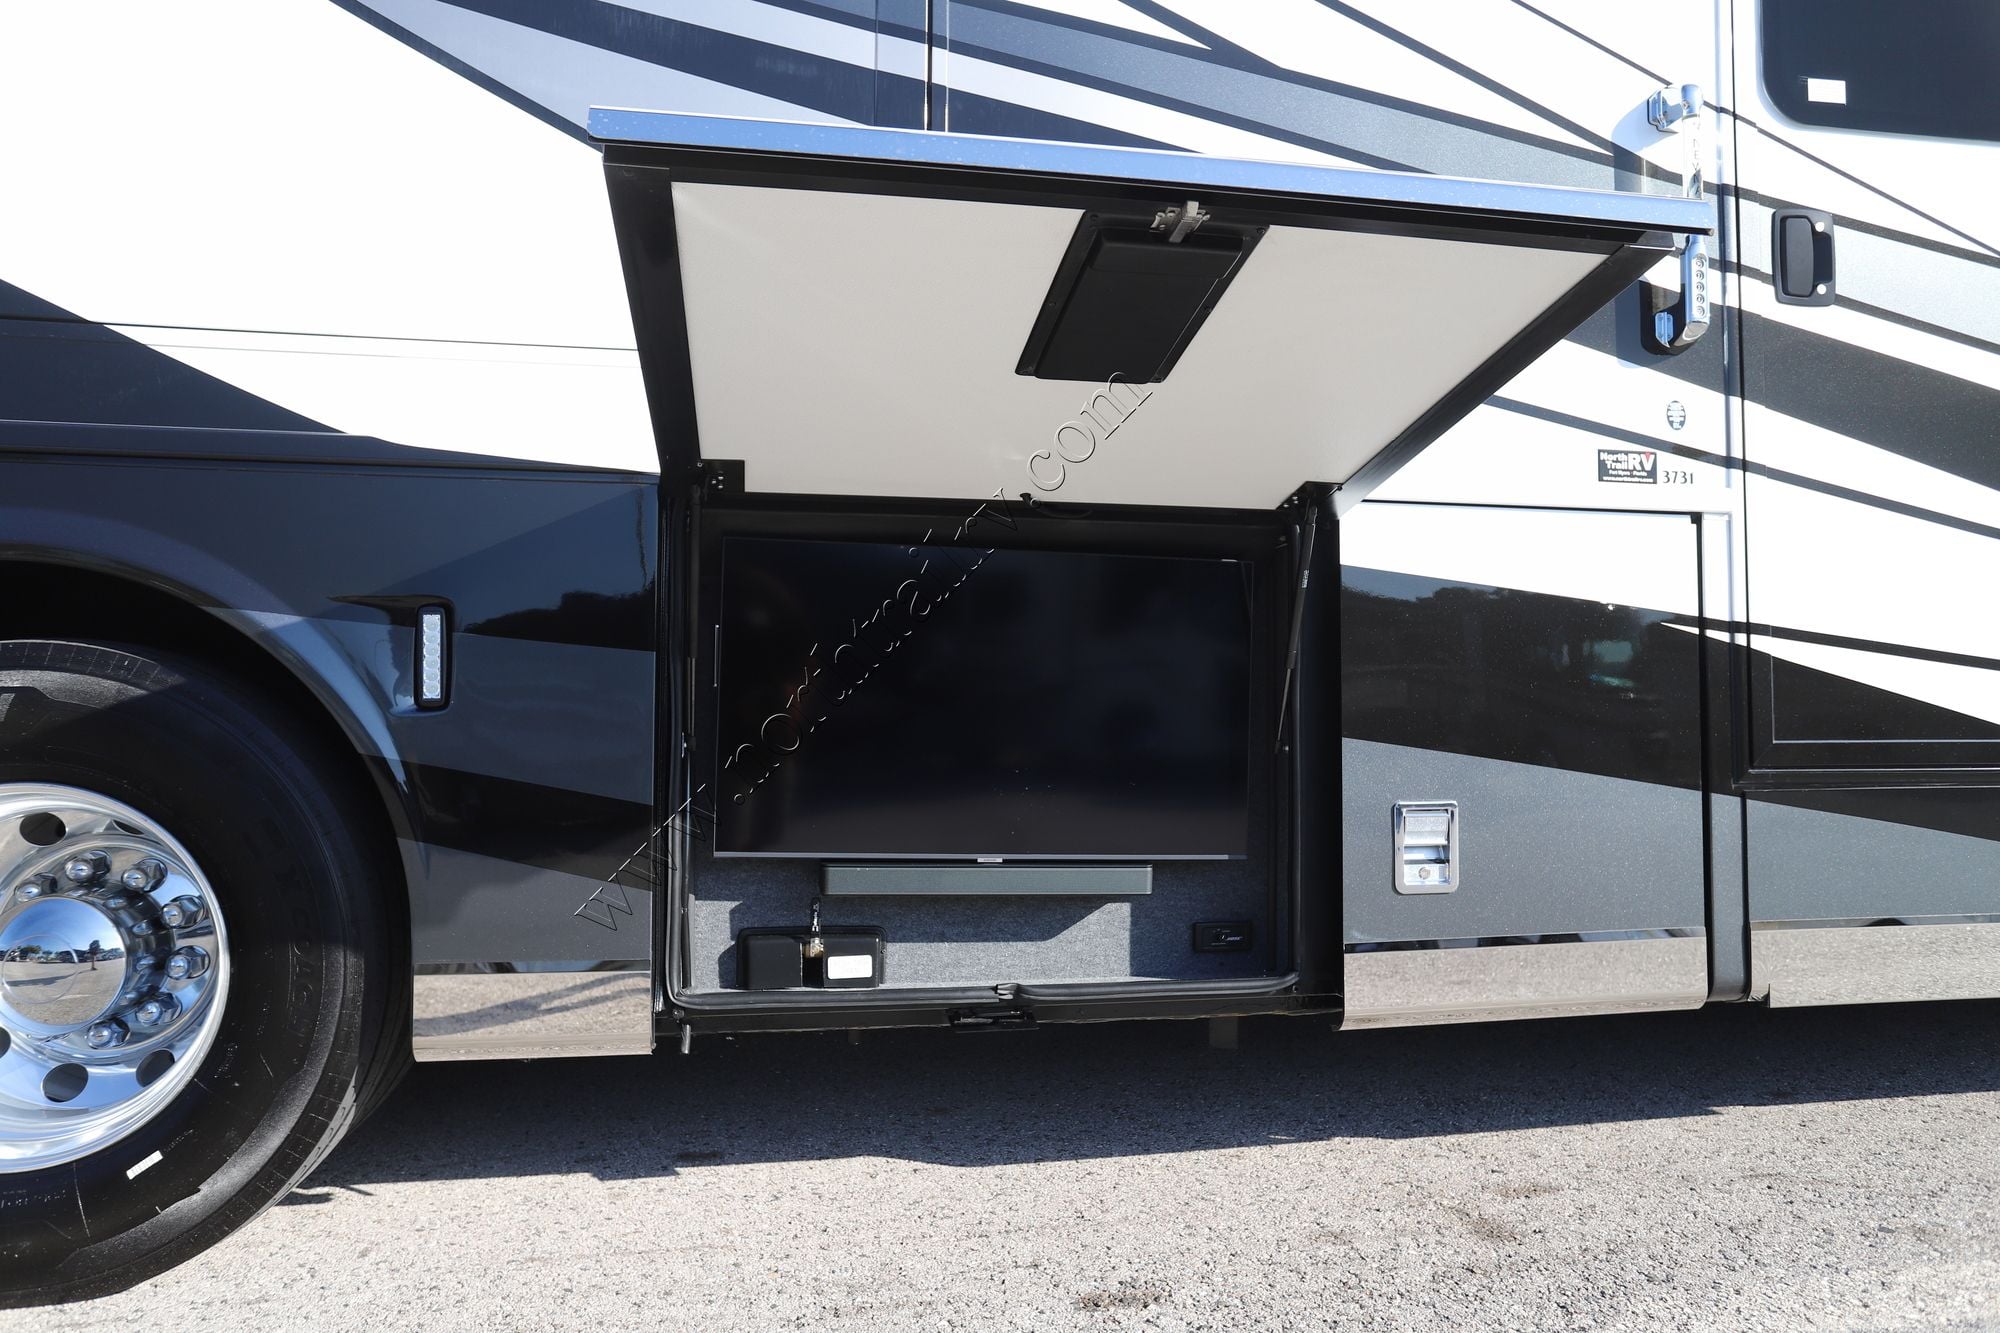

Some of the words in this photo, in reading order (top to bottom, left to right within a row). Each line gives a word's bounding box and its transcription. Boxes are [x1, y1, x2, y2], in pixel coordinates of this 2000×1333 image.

[1600, 452, 1628, 461] North
[1628, 452, 1655, 471] RV
[1605, 460, 1628, 470] Trail
[1663, 471, 1693, 484] 3731
